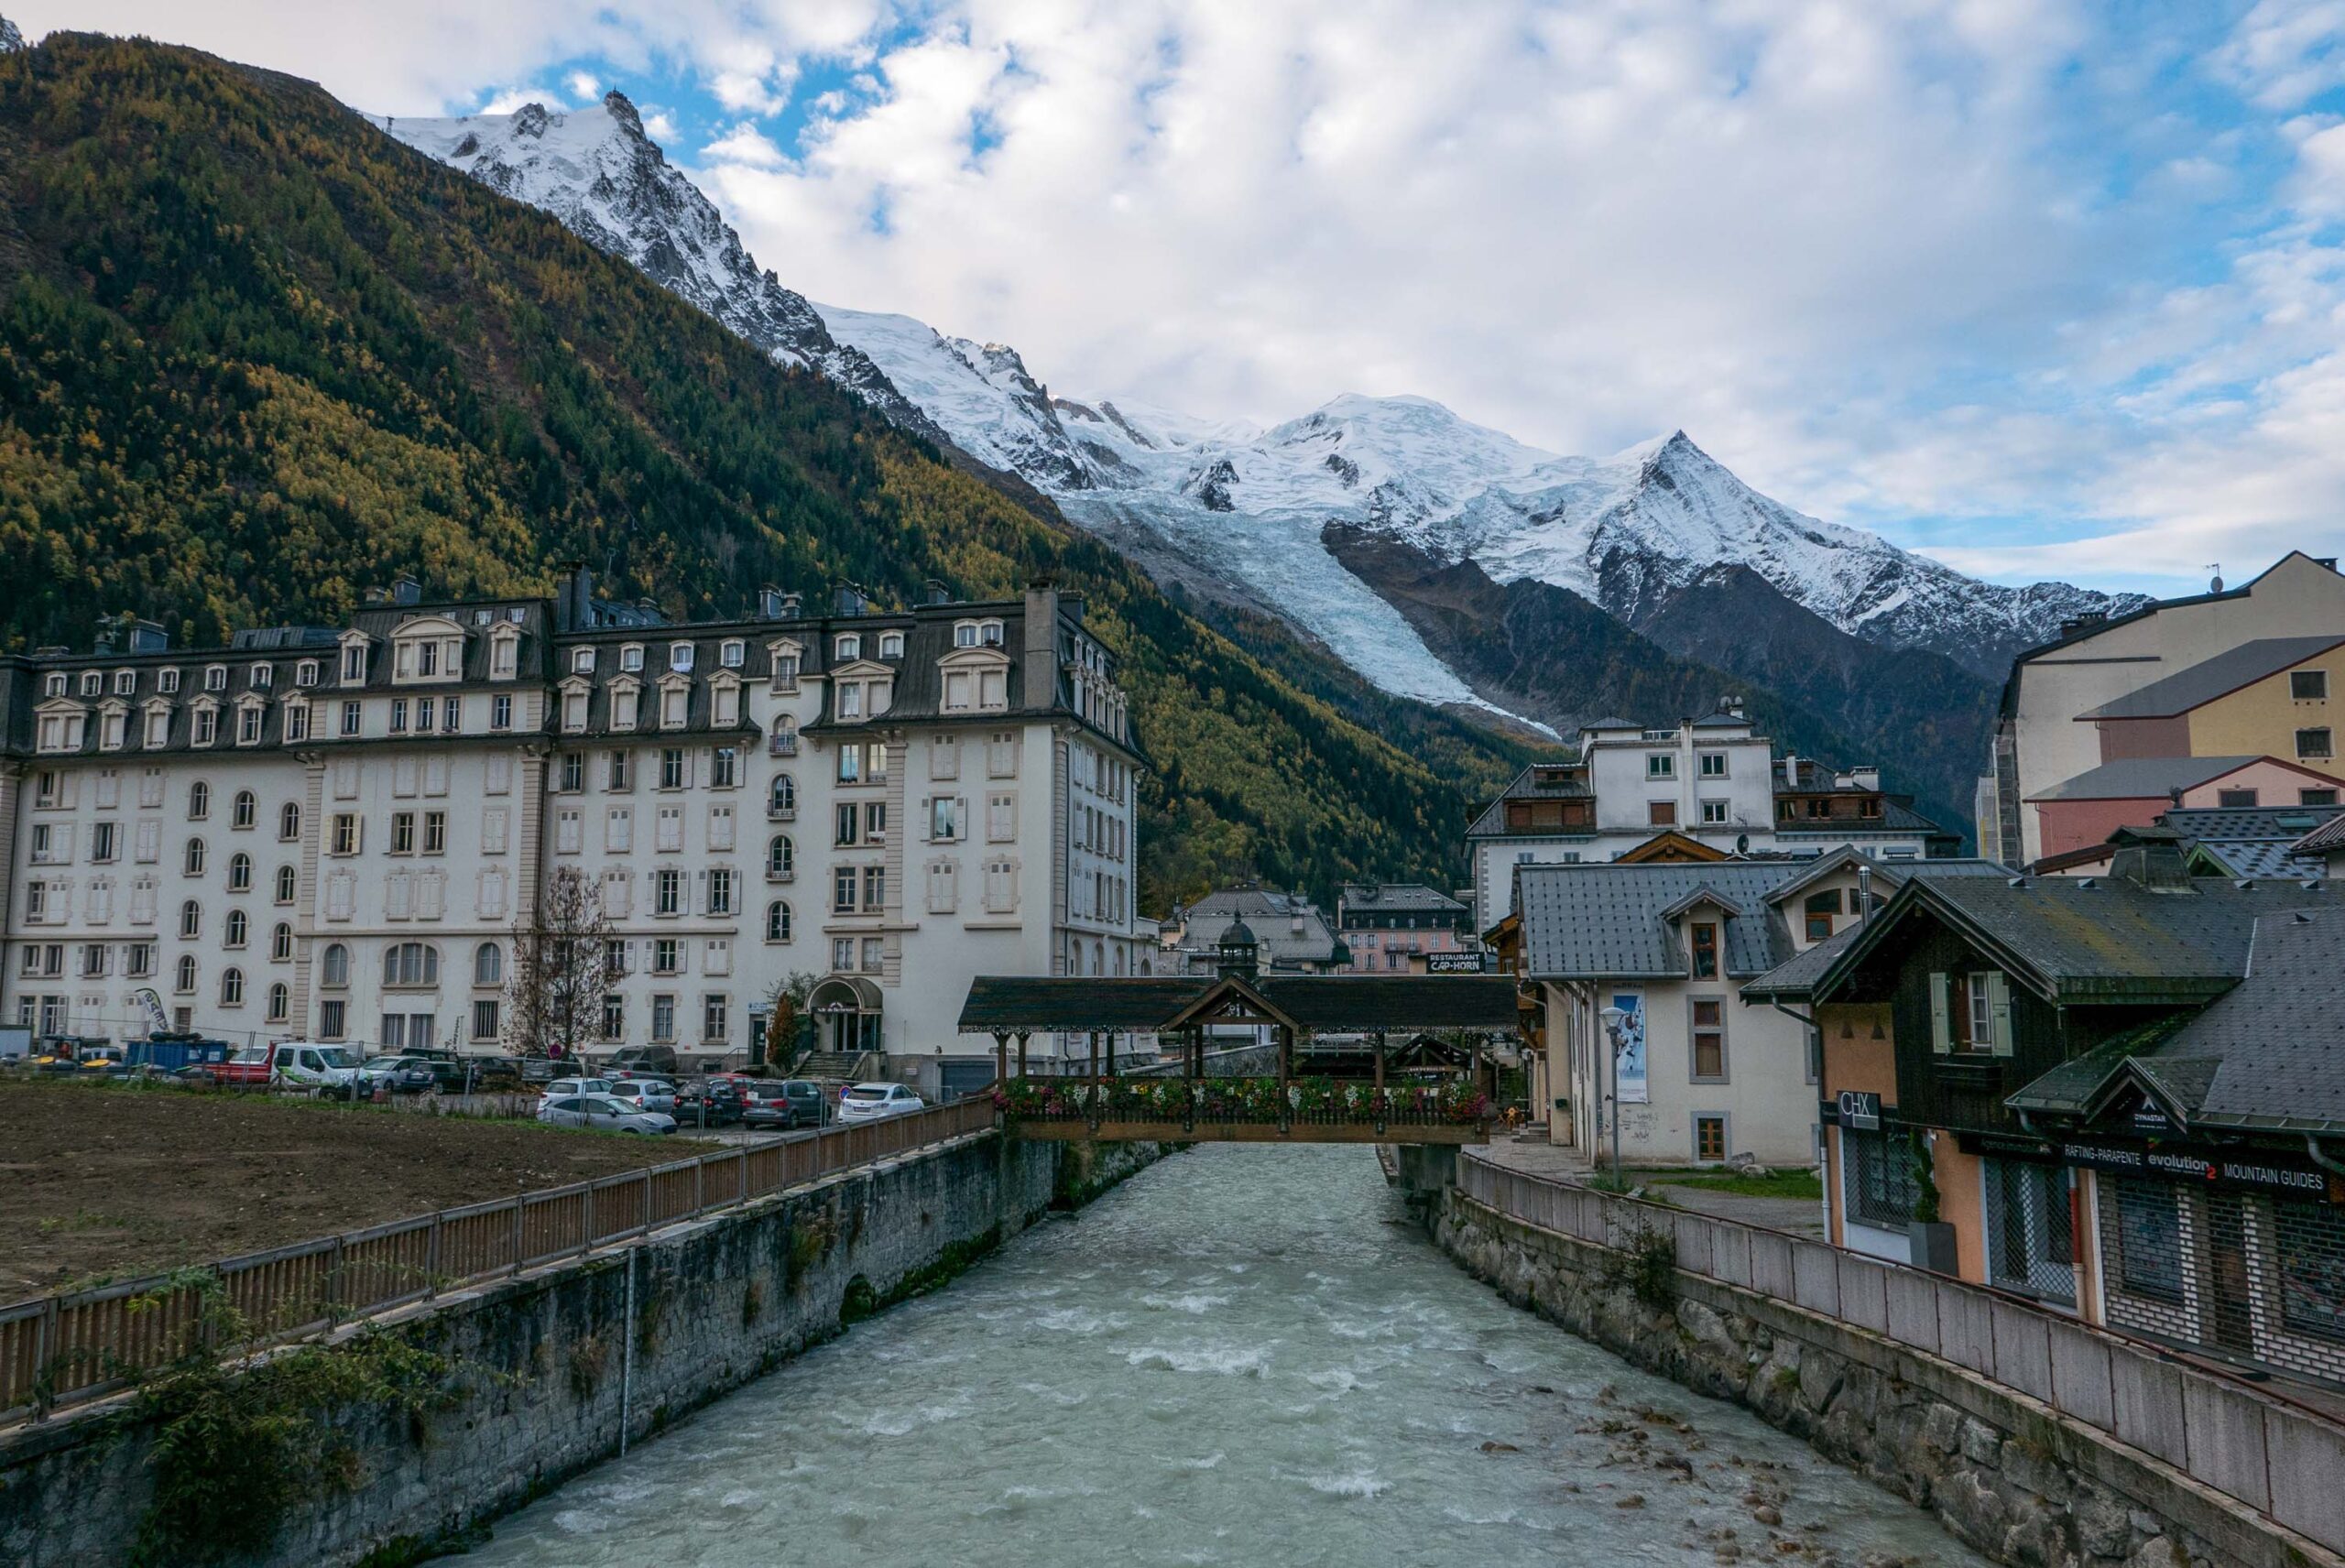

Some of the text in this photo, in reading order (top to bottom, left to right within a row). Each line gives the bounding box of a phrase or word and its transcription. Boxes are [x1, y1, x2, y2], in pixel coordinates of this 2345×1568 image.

[1840, 1092, 1870, 1116] CHX
[2134, 1113, 2166, 1122] DYNASTAR
[2065, 1144, 2142, 1165] RAFTING-PARAPENTE
[2223, 1163, 2279, 1183] MOUNTAIN
[2280, 1171, 2324, 1190] GUIDES
